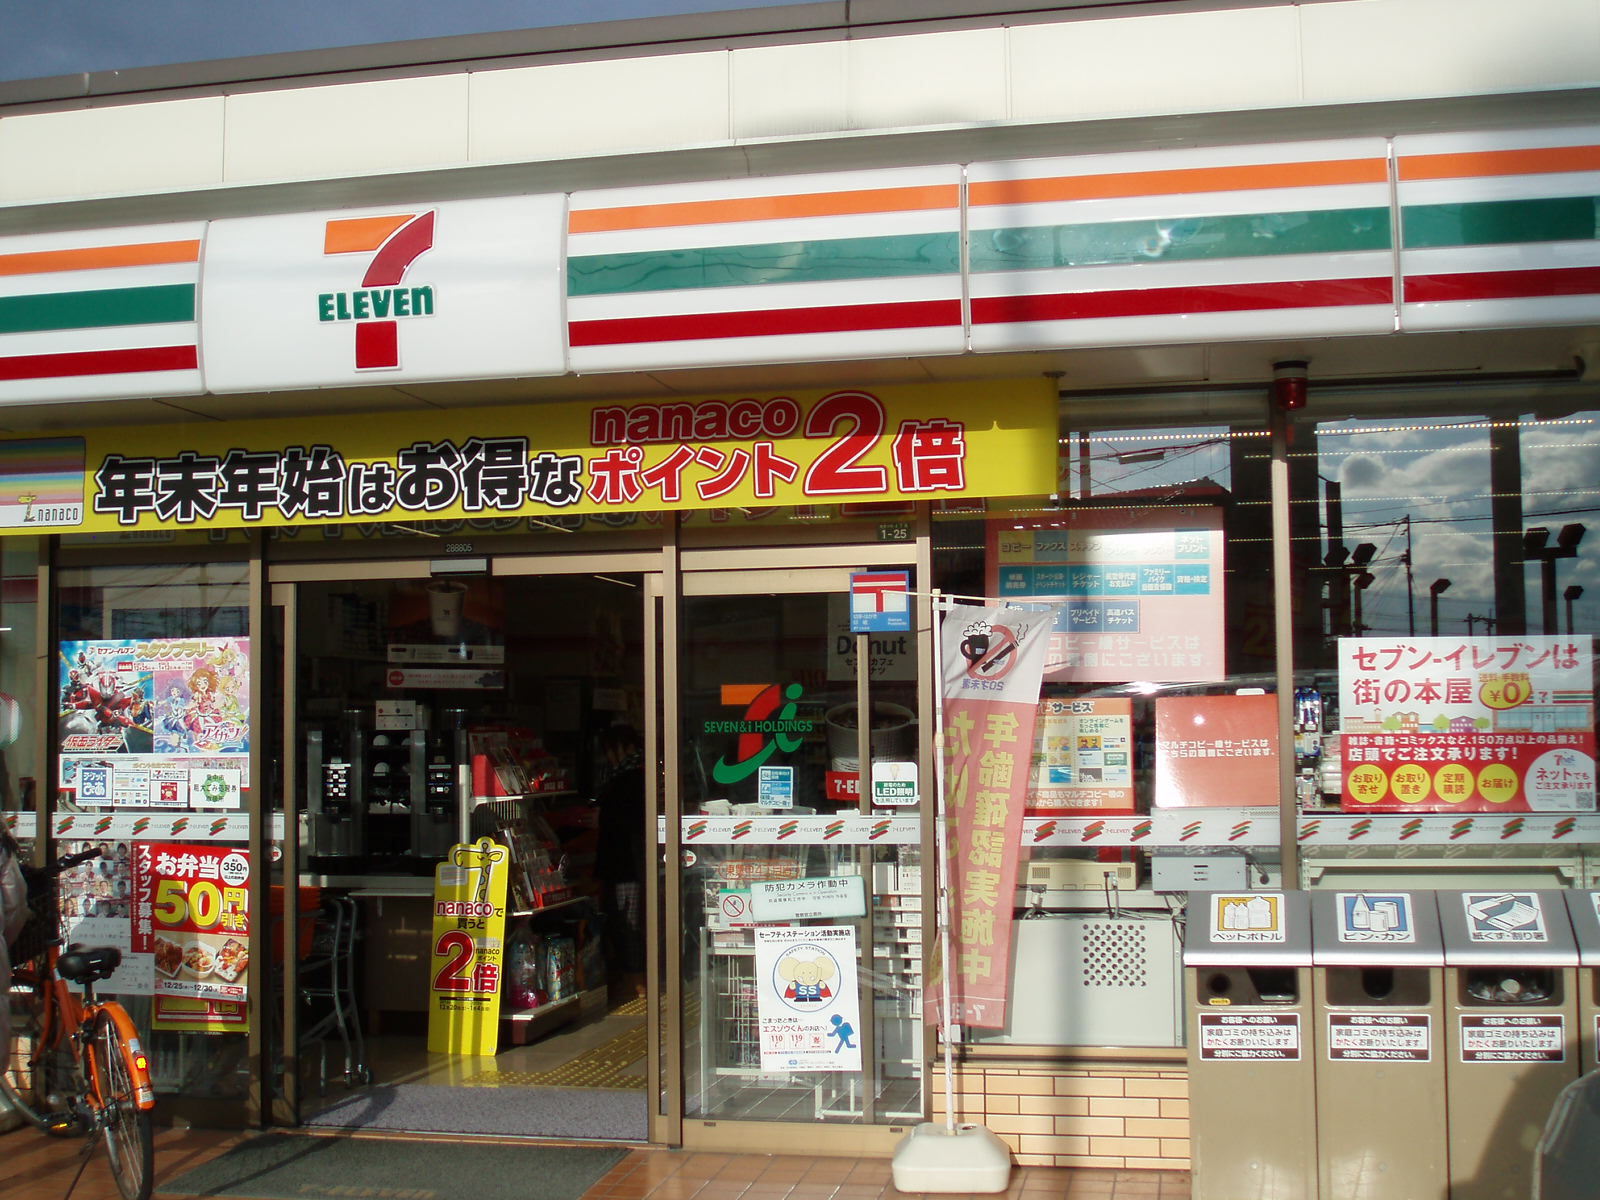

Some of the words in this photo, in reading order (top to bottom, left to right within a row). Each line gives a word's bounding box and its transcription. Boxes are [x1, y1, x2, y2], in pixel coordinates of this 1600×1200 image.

[591, 398, 799, 446] nanaco
[587, 443, 799, 504] ポイント
[94, 437, 582, 524] 年末年始はお得な
[38, 507, 79, 522] nanaco
[881, 529, 907, 539] 1-25
[1002, 543, 1032, 552] コピー
[1108, 617, 1134, 625] チケット
[136, 641, 216, 659] スタンプラリー
[836, 635, 906, 655] Dnut
[1351, 643, 1580, 672] セブン-イレブンは
[1352, 677, 1473, 706] 街の本屋
[704, 720, 752, 733] SEVEN&i
[755, 720, 813, 733] HOLDINGS
[1168, 748, 1275, 758] ちらの裏側にございます。
[1348, 746, 1518, 762] 店頭でご注文承ります!
[1352, 773, 1383, 783] お取り
[1395, 773, 1426, 783] お取り
[1443, 773, 1465, 783] 定期
[1481, 778, 1514, 789] お届け
[1535, 781, 1593, 790] ご注文承ります
[876, 787, 914, 797] LED照明
[1357, 784, 1378, 794] 寄せ
[1401, 784, 1421, 794] 置き
[155, 851, 220, 880] お弁当
[764, 879, 849, 893] 防犯カメラ作動中
[457, 918, 486, 930] 買うと
[1213, 932, 1283, 941] ペットボトル
[475, 947, 500, 955] nanaco
[799, 986, 817, 995] SS
[1206, 1028, 1291, 1037] 家庭ゴミの持ち込みは
